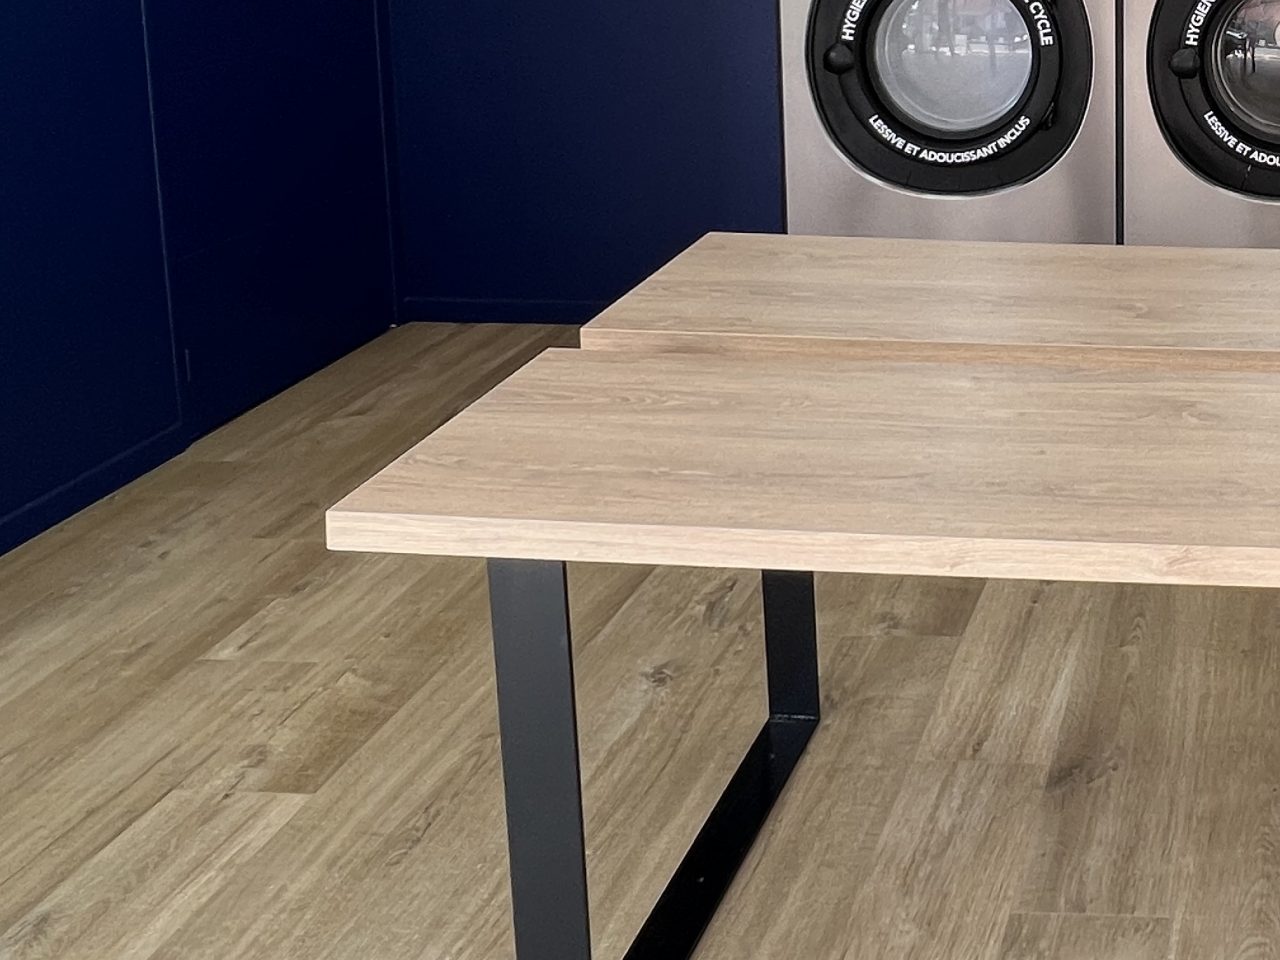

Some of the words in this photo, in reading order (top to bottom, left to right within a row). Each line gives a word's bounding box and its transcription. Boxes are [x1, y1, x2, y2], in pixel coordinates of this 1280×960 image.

[1029, 2, 1053, 46] CYCLE
[869, 115, 905, 148] LESSIVE
[904, 142, 920, 156] ET
[919, 142, 999, 163] ADOUCISSANT
[997, 115, 1031, 148] INCLUS
[1203, 111, 1237, 148] LESSIVE
[1235, 143, 1251, 156] ET
